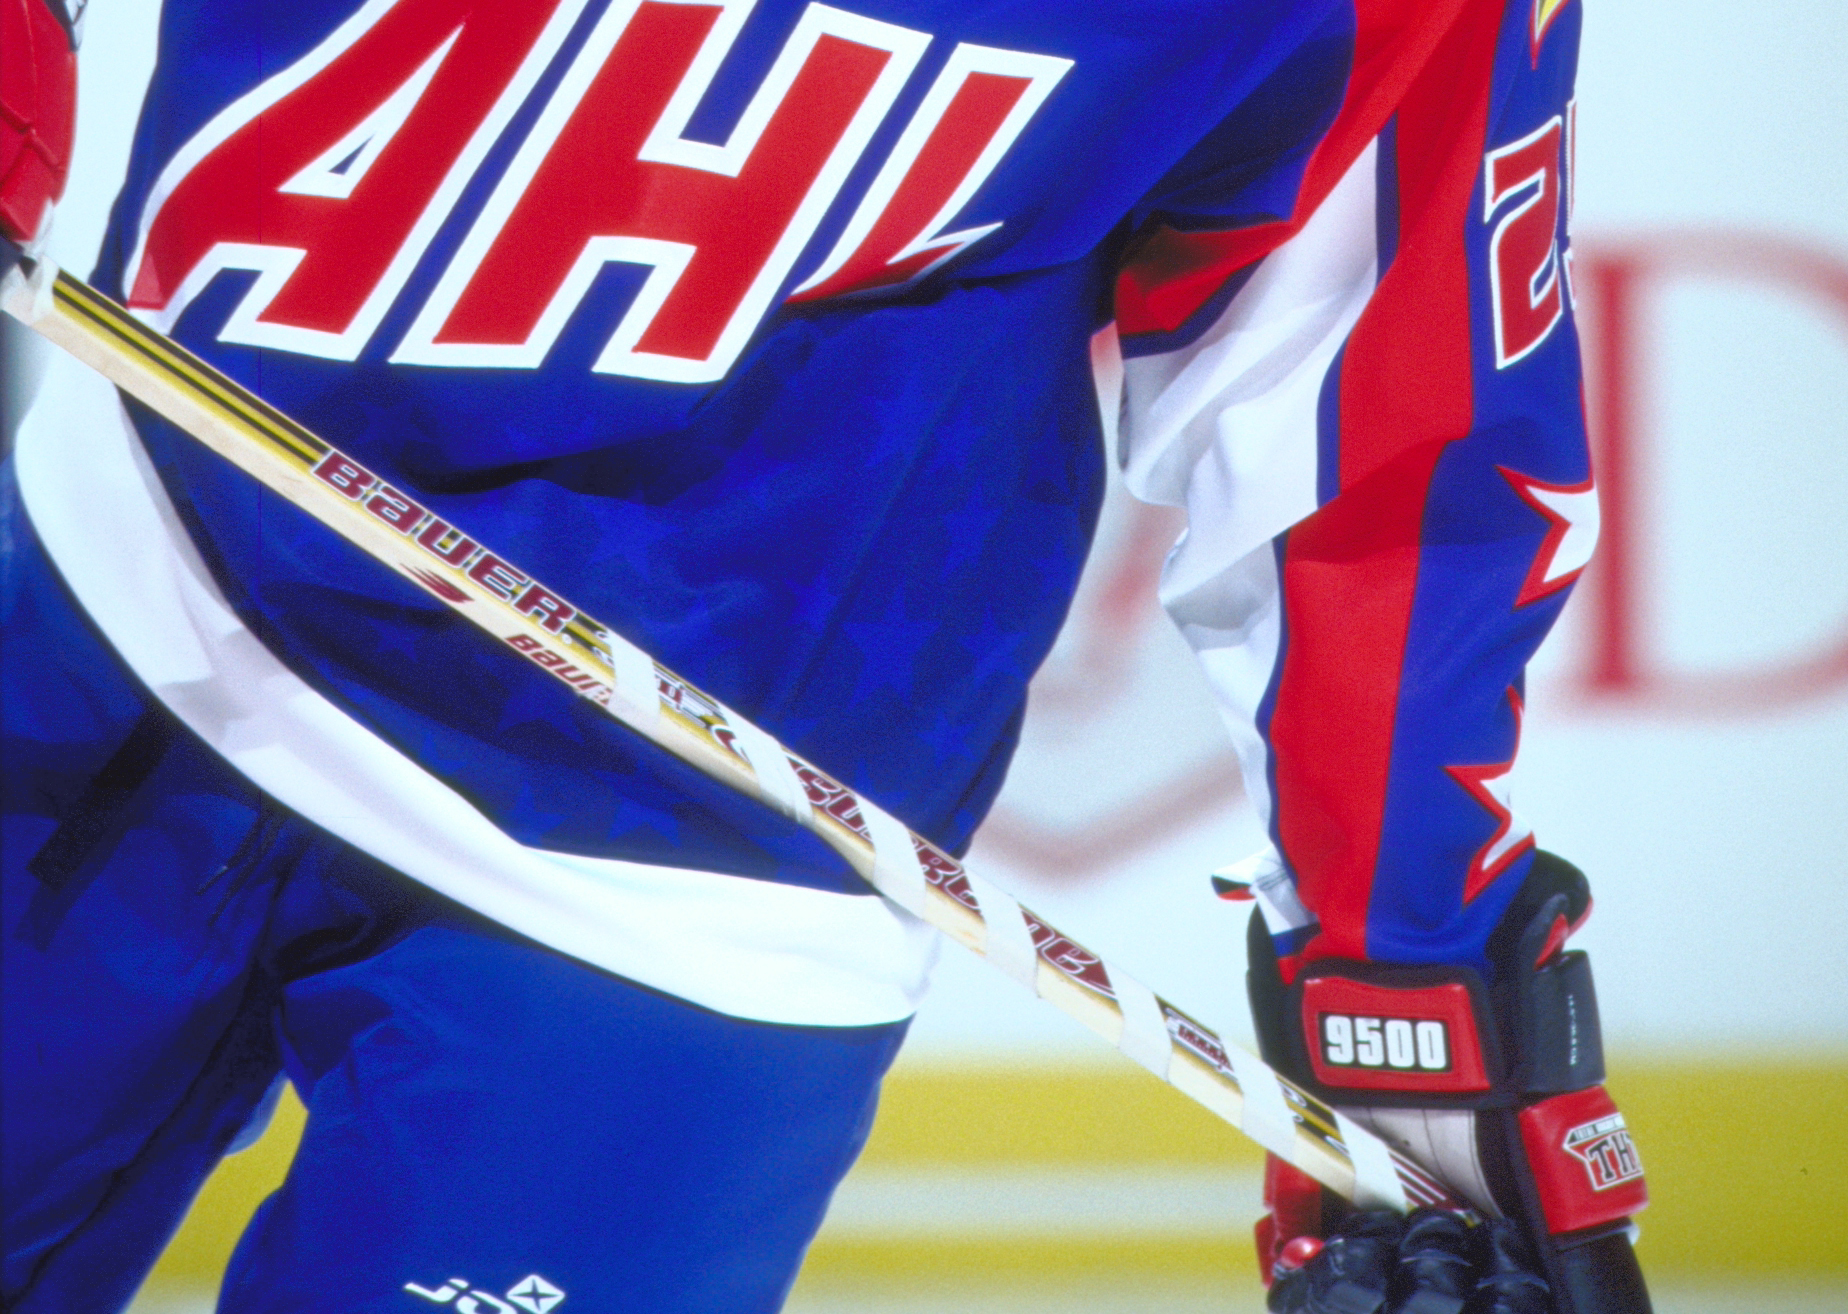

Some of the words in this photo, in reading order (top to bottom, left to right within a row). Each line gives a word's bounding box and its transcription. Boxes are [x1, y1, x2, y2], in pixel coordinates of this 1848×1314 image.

[1484, 97, 1577, 370] 2
[1323, 1014, 1449, 1071] 9500
[1586, 1131, 1640, 1182] TH
